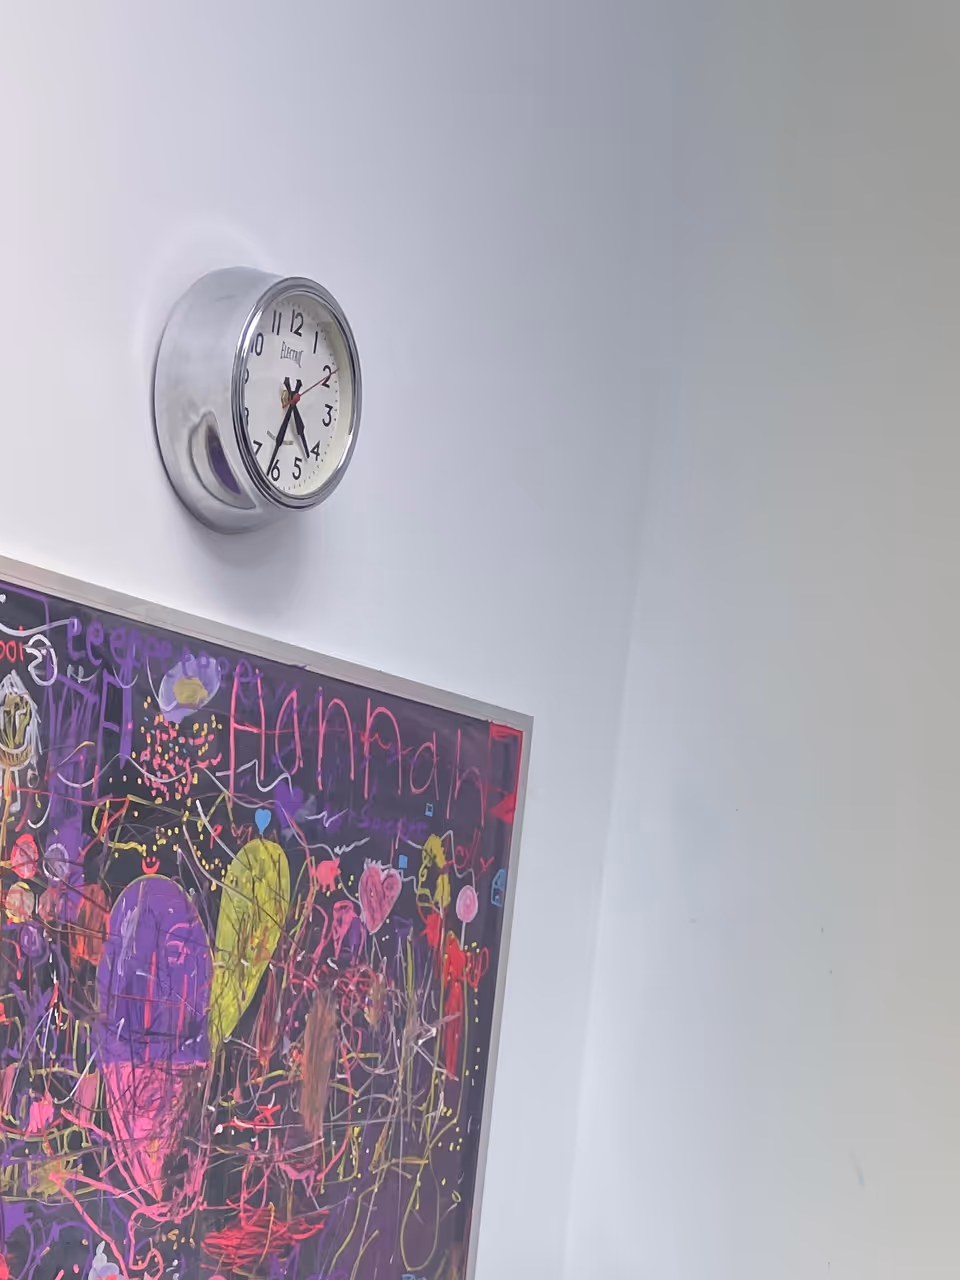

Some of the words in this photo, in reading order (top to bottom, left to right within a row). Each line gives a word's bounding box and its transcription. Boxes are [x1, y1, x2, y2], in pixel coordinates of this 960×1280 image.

[272, 310, 282, 336] 11
[290, 309, 304, 337] 12
[250, 332, 264, 356] 10
[313, 331, 319, 354] 1
[321, 365, 332, 388] 2
[322, 404, 333, 427] 3
[310, 440, 320, 461] 4
[271, 459, 280, 481] 6
[292, 457, 302, 480] 5
[227, 664, 486, 828] Hannah
